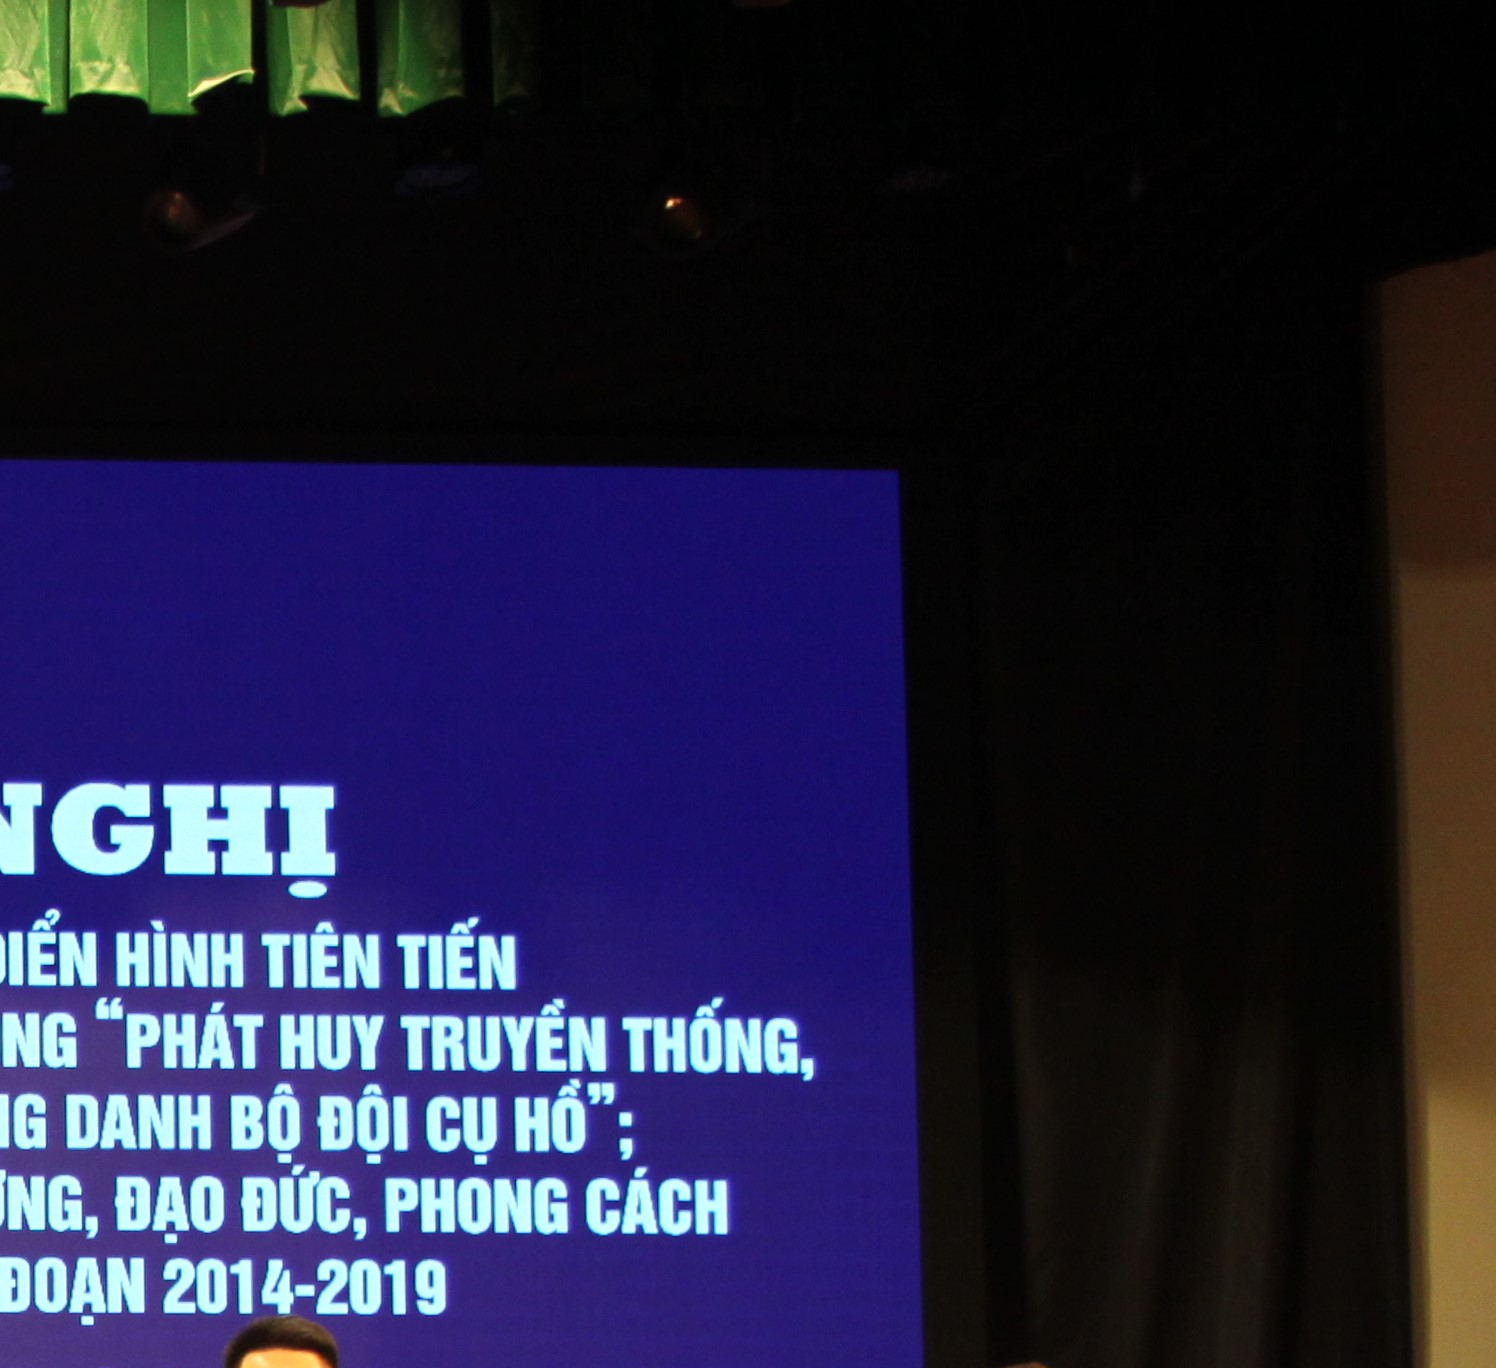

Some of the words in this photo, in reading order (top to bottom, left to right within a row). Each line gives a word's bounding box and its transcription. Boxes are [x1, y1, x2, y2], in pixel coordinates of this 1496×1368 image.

[115, 919, 245, 988] HÌNH
[260, 921, 381, 989] TIÊN
[396, 916, 517, 991] TIẾN
[279, 1014, 385, 1071] HUY
[399, 998, 607, 1073] TRUYỀN
[621, 996, 815, 1082] THỐNG,
[65, 1093, 212, 1151] DANH
[230, 1082, 301, 1164] BỘ
[316, 1083, 409, 1165] ĐỘI
[425, 1095, 498, 1166] CỤ
[114, 1175, 225, 1244] ĐẠO
[240, 1163, 367, 1241] ĐỨC,
[384, 1178, 569, 1236] PHONG
[585, 1166, 729, 1237] CÁCH
[162, 1257, 447, 1316] 2014-2019
